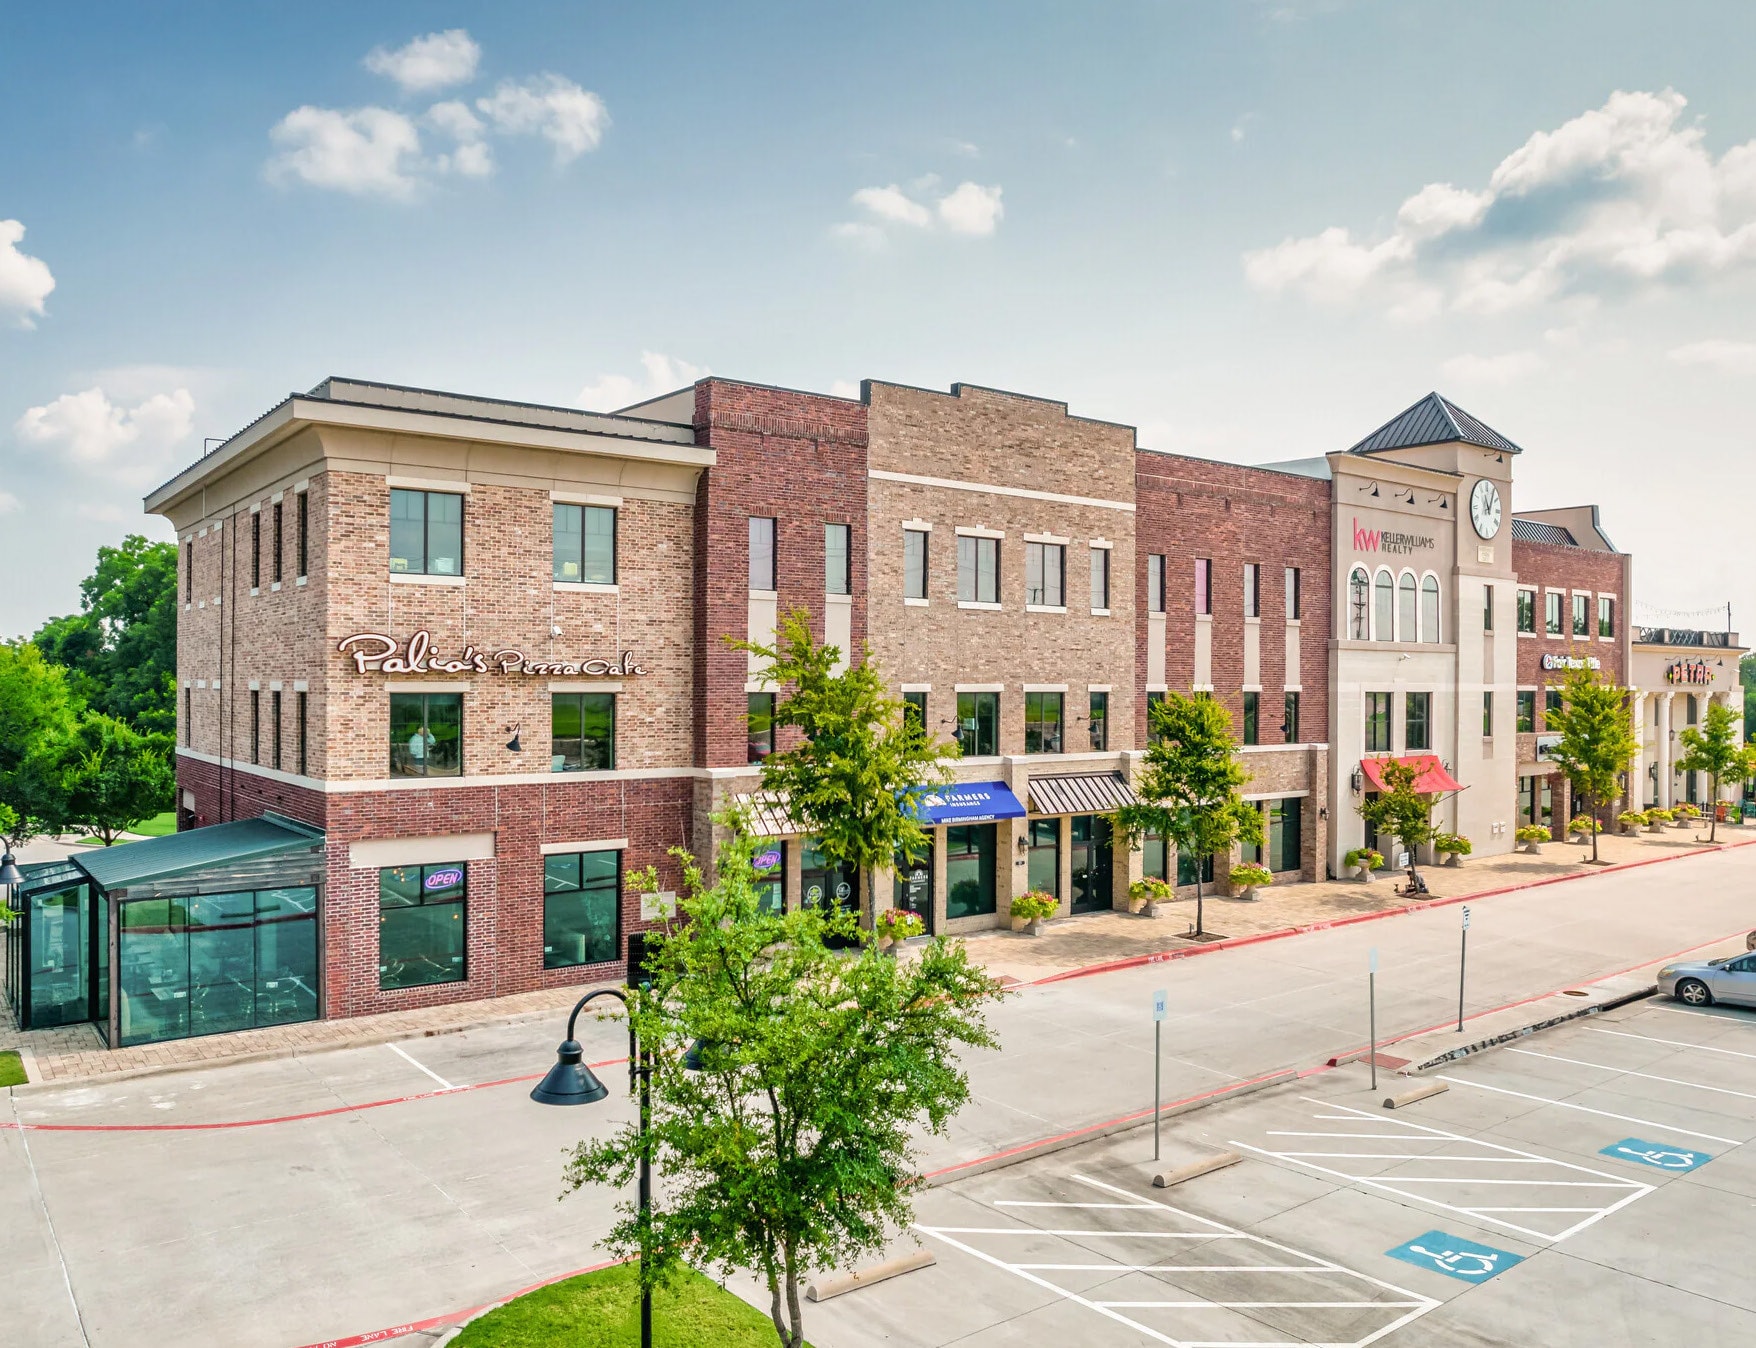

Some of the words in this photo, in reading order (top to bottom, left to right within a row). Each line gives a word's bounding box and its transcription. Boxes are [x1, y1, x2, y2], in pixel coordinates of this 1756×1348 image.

[1382, 543, 1413, 555] REALTY
[338, 630, 490, 675] Palio's
[492, 649, 579, 676] Pizza
[1672, 664, 1713, 684] PETRA
[944, 792, 991, 802] FARMERS
[427, 872, 459, 886] OPEN
[391, 1325, 414, 1335] FIRE
[361, 1331, 388, 1342] LANE
